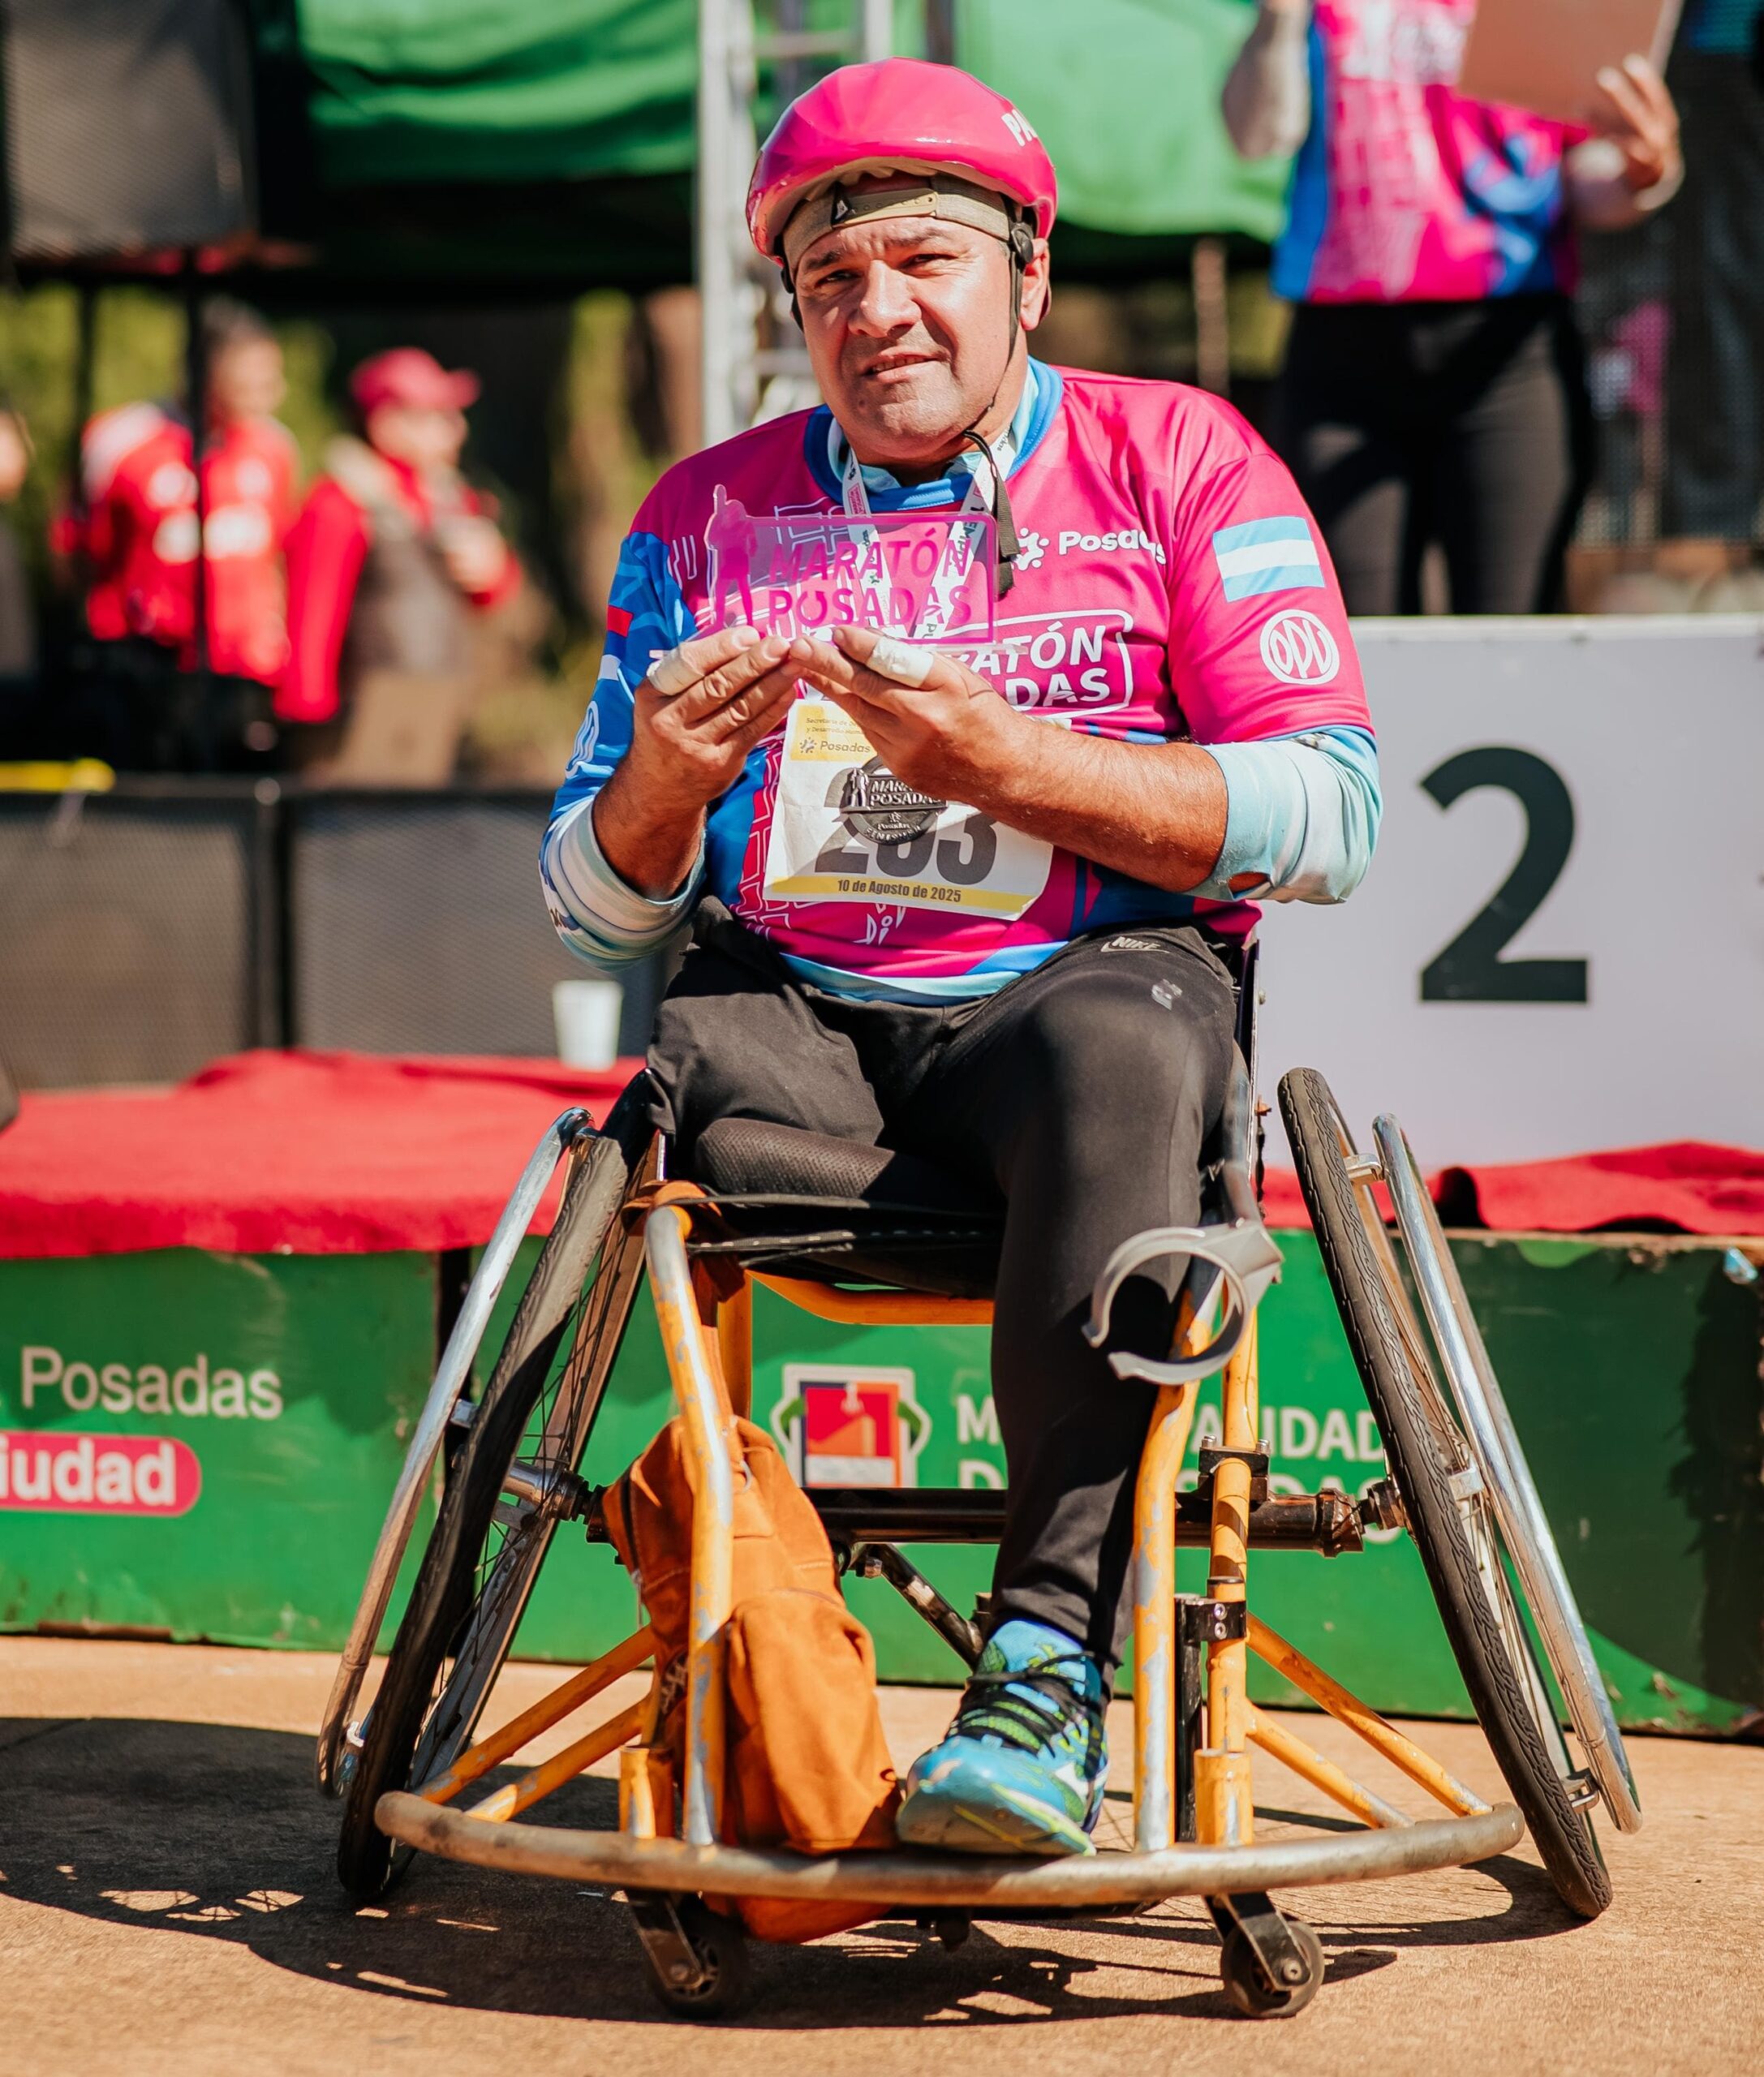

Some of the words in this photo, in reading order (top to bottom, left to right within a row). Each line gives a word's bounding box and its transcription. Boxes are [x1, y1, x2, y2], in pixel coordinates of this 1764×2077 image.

[768, 527, 972, 583] MARATÓN
[768, 585, 972, 628] POSADAS
[820, 740, 871, 753] Posadas
[837, 879, 850, 892] 10
[852, 880, 867, 892] de
[868, 880, 910, 896] Agosto
[912, 884, 928, 898] de
[930, 887, 962, 903] 2025
[1421, 746, 1588, 1002] 2
[21, 1345, 283, 1420] Posadas
[0, 1434, 176, 1507] iudad
